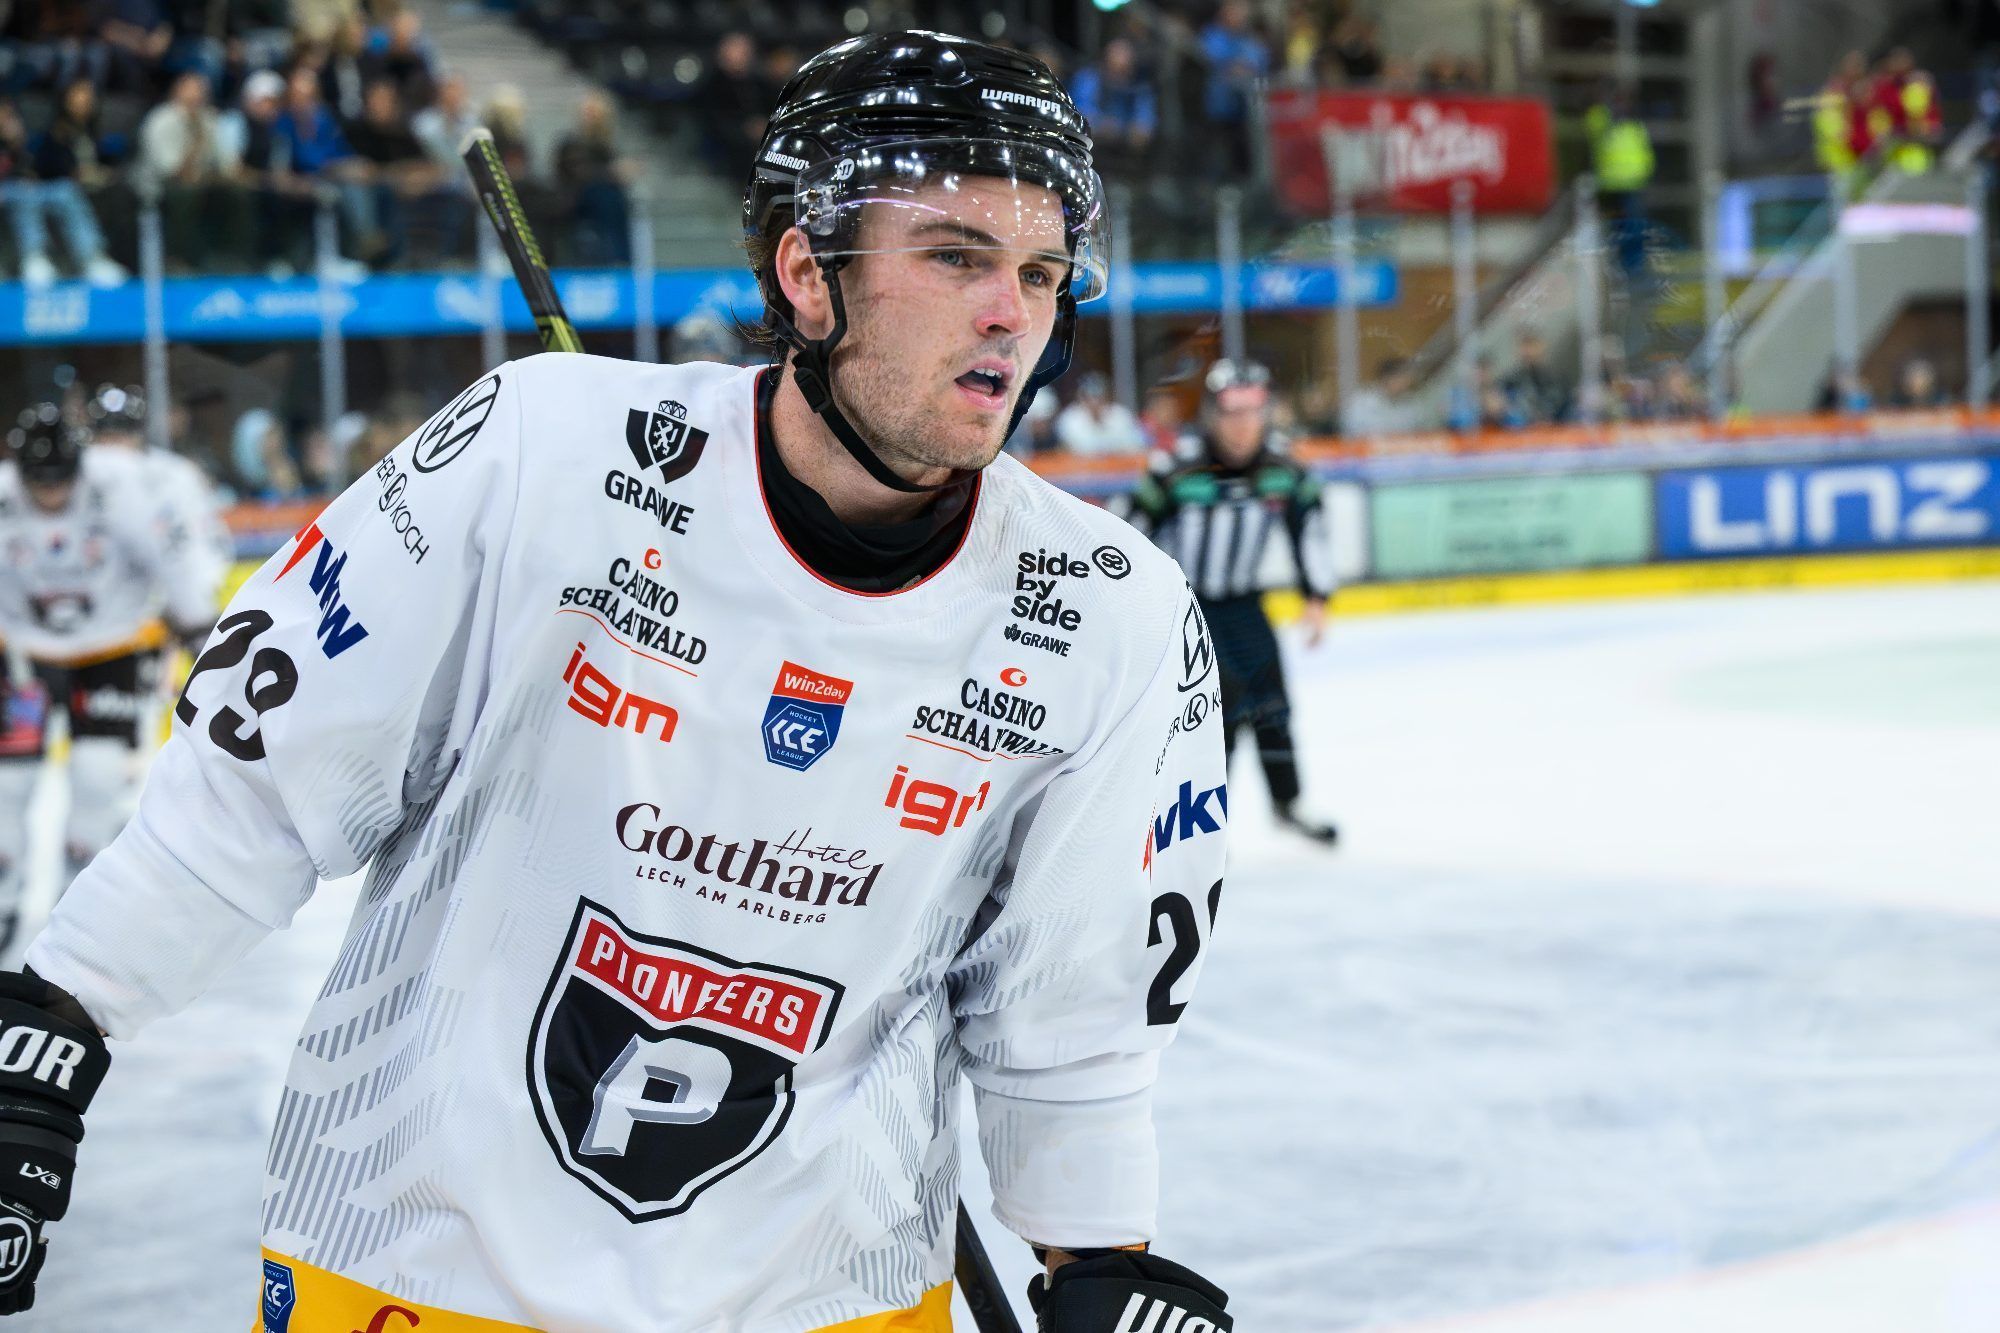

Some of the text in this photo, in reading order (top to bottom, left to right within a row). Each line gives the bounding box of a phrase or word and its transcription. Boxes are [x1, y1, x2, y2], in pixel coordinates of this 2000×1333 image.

[981, 88, 1061, 113] WARRIOR
[604, 469, 695, 536] GRAWE
[390, 499, 430, 565] KOCH
[1016, 571, 1058, 601] by
[1017, 548, 1090, 578] side
[1020, 631, 1072, 658] GRAWE
[175, 609, 299, 762] 29
[562, 641, 679, 743] igm
[960, 677, 1047, 732] CASINO
[771, 718, 825, 755] ICE
[789, 709, 818, 724] HOCKEY
[776, 748, 805, 761] LEAGUE
[615, 802, 885, 907] Gotthard
[773, 827, 871, 870] Hotel
[635, 865, 827, 925] LECH AM ARLBERG
[590, 931, 805, 1037] PIONEERS
[577, 1033, 733, 1157] P
[19, 1161, 62, 1190] LX3
